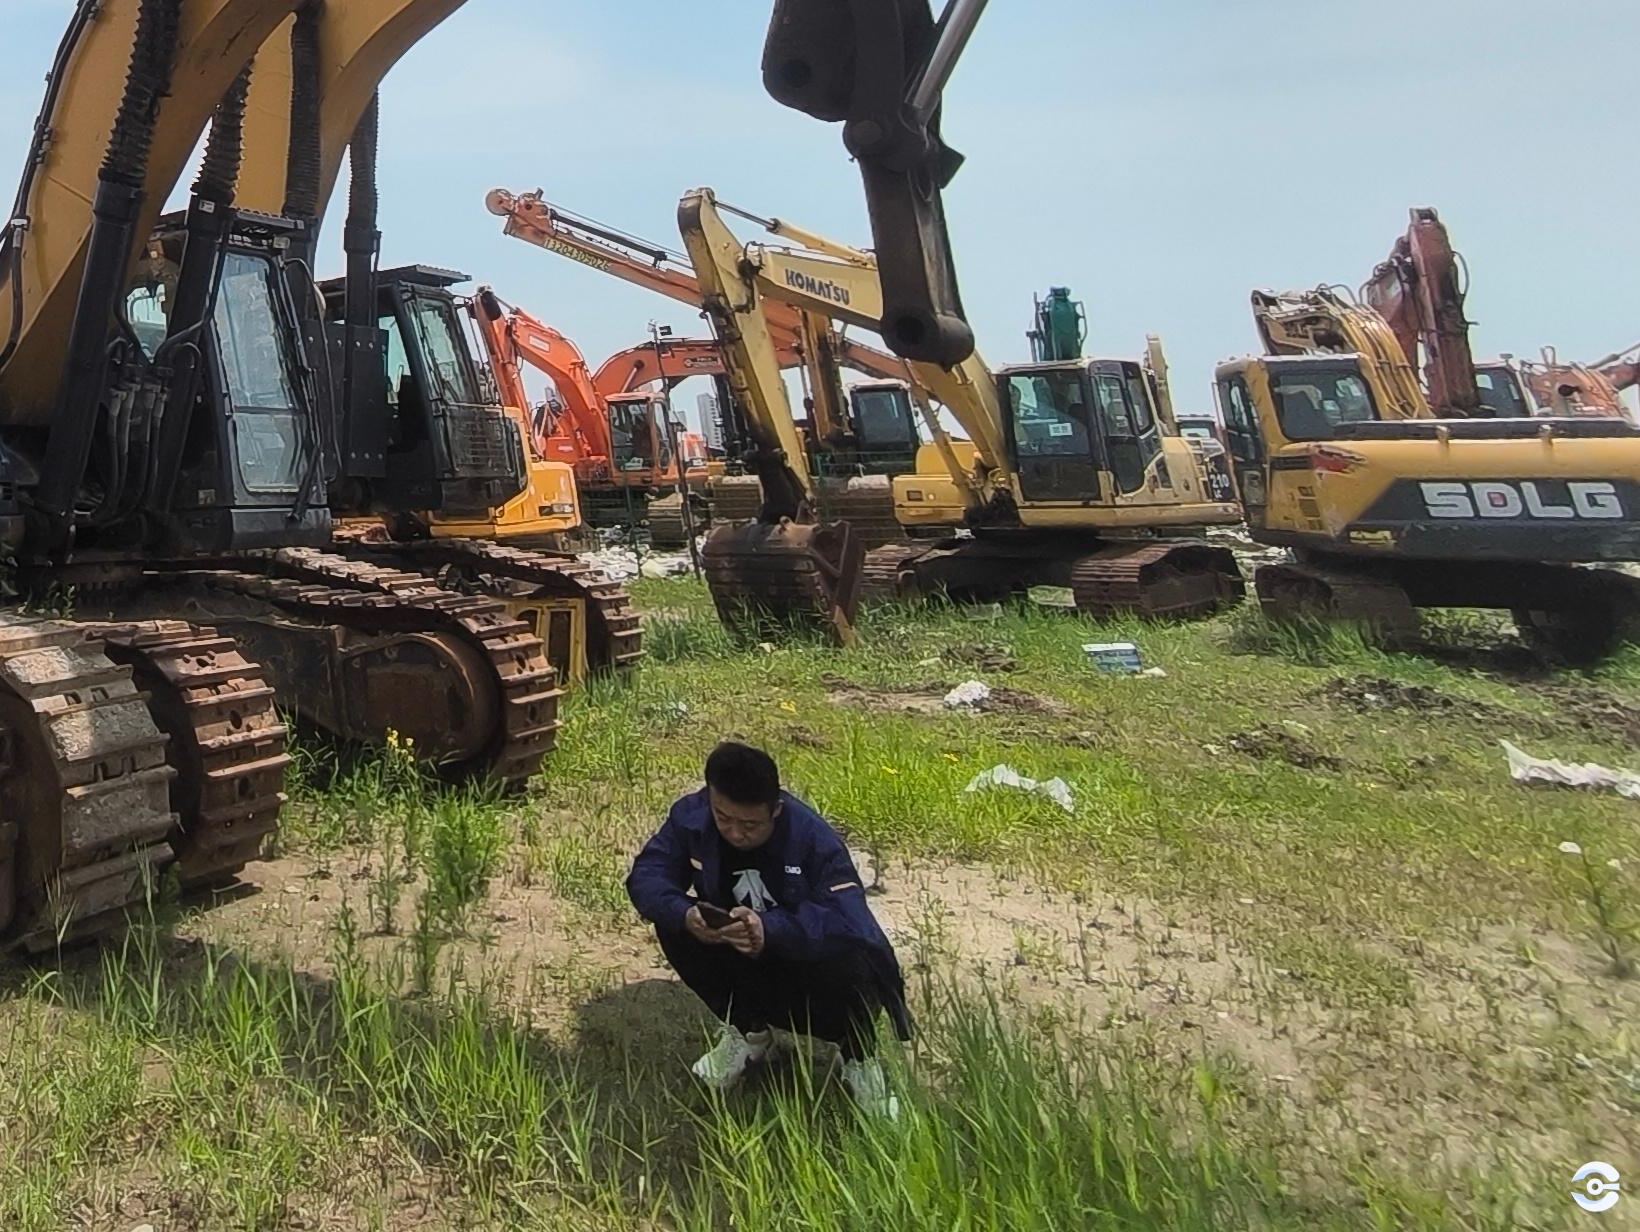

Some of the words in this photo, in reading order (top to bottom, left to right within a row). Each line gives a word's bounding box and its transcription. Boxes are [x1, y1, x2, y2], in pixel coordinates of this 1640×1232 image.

[785, 268, 850, 306] KOMATSU
[1210, 473, 1230, 488] 210
[1418, 481, 1625, 519] SDLG
